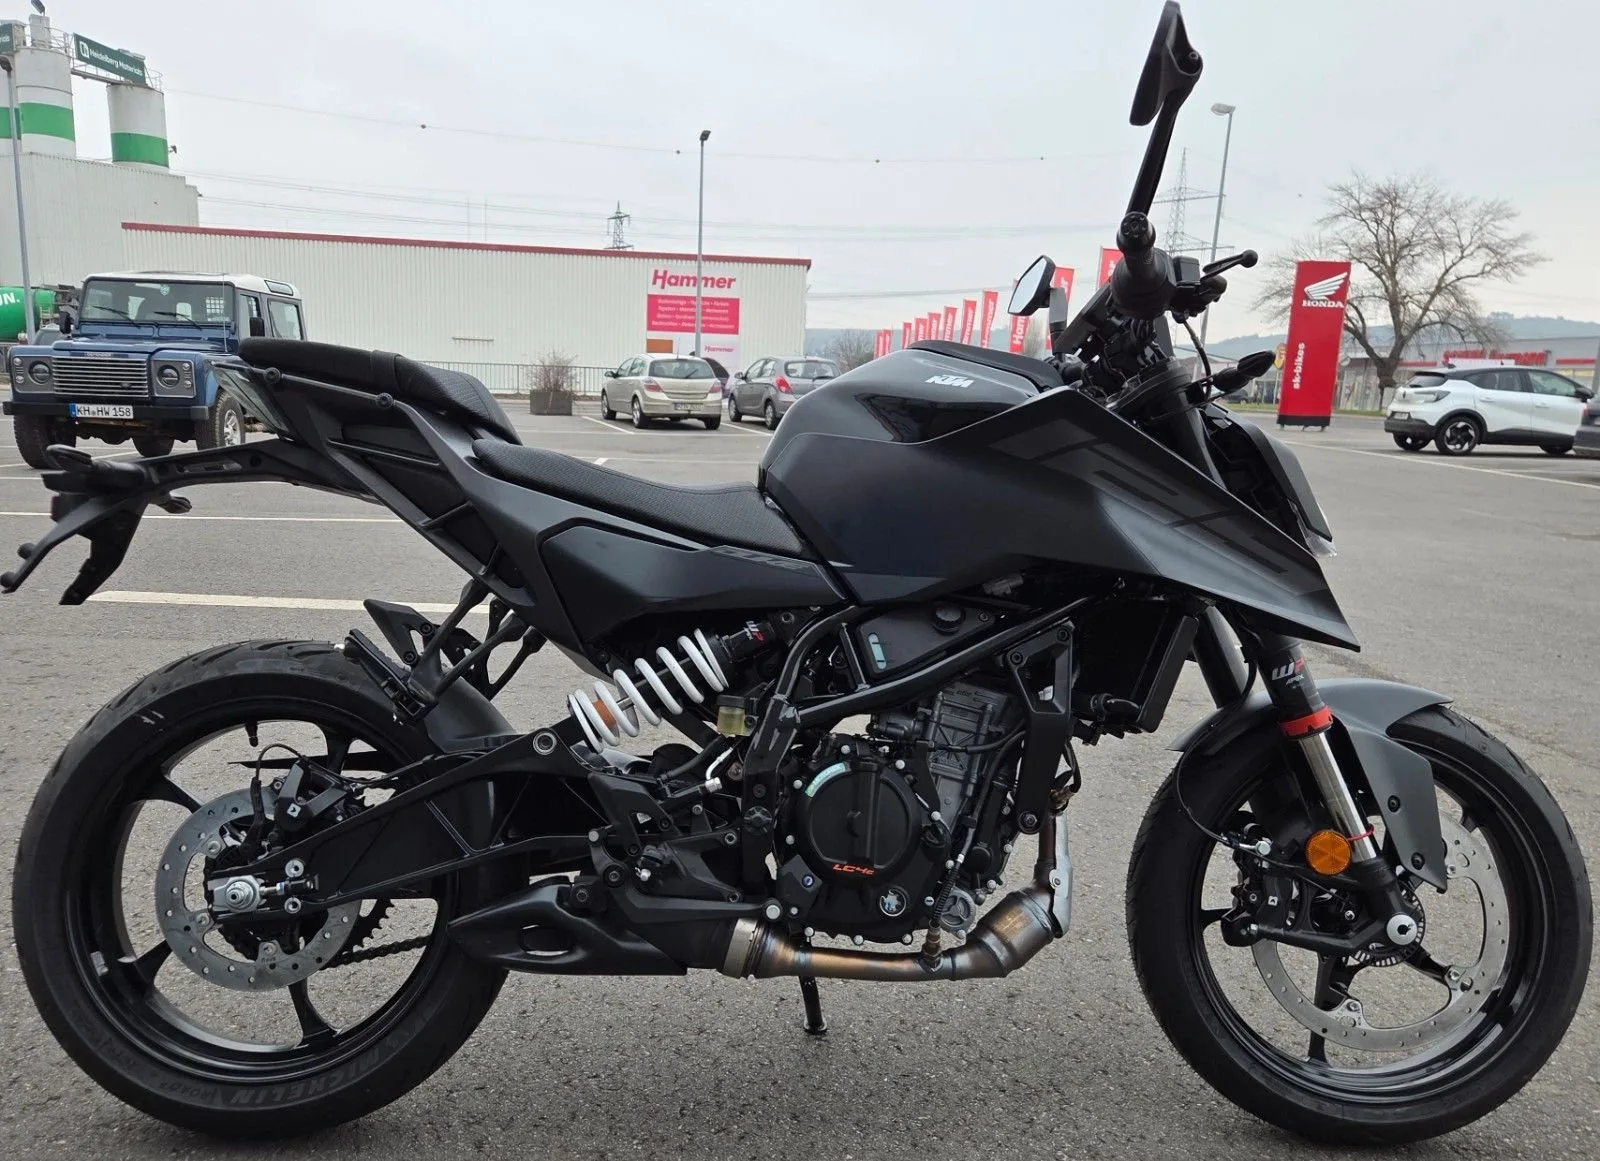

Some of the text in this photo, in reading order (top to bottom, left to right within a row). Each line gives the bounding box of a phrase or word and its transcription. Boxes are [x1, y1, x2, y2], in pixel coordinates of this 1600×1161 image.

[89, 48, 143, 76] Heidelberg Materials
[652, 269, 736, 290] Hammer
[1302, 300, 1344, 308] HONDA
[704, 345, 734, 353] Hammer
[1292, 342, 1306, 390] sk-bikes
[925, 374, 974, 388] KTM
[77, 405, 131, 417] KH HW 158
[230, 1049, 381, 1105] MICHELIN
